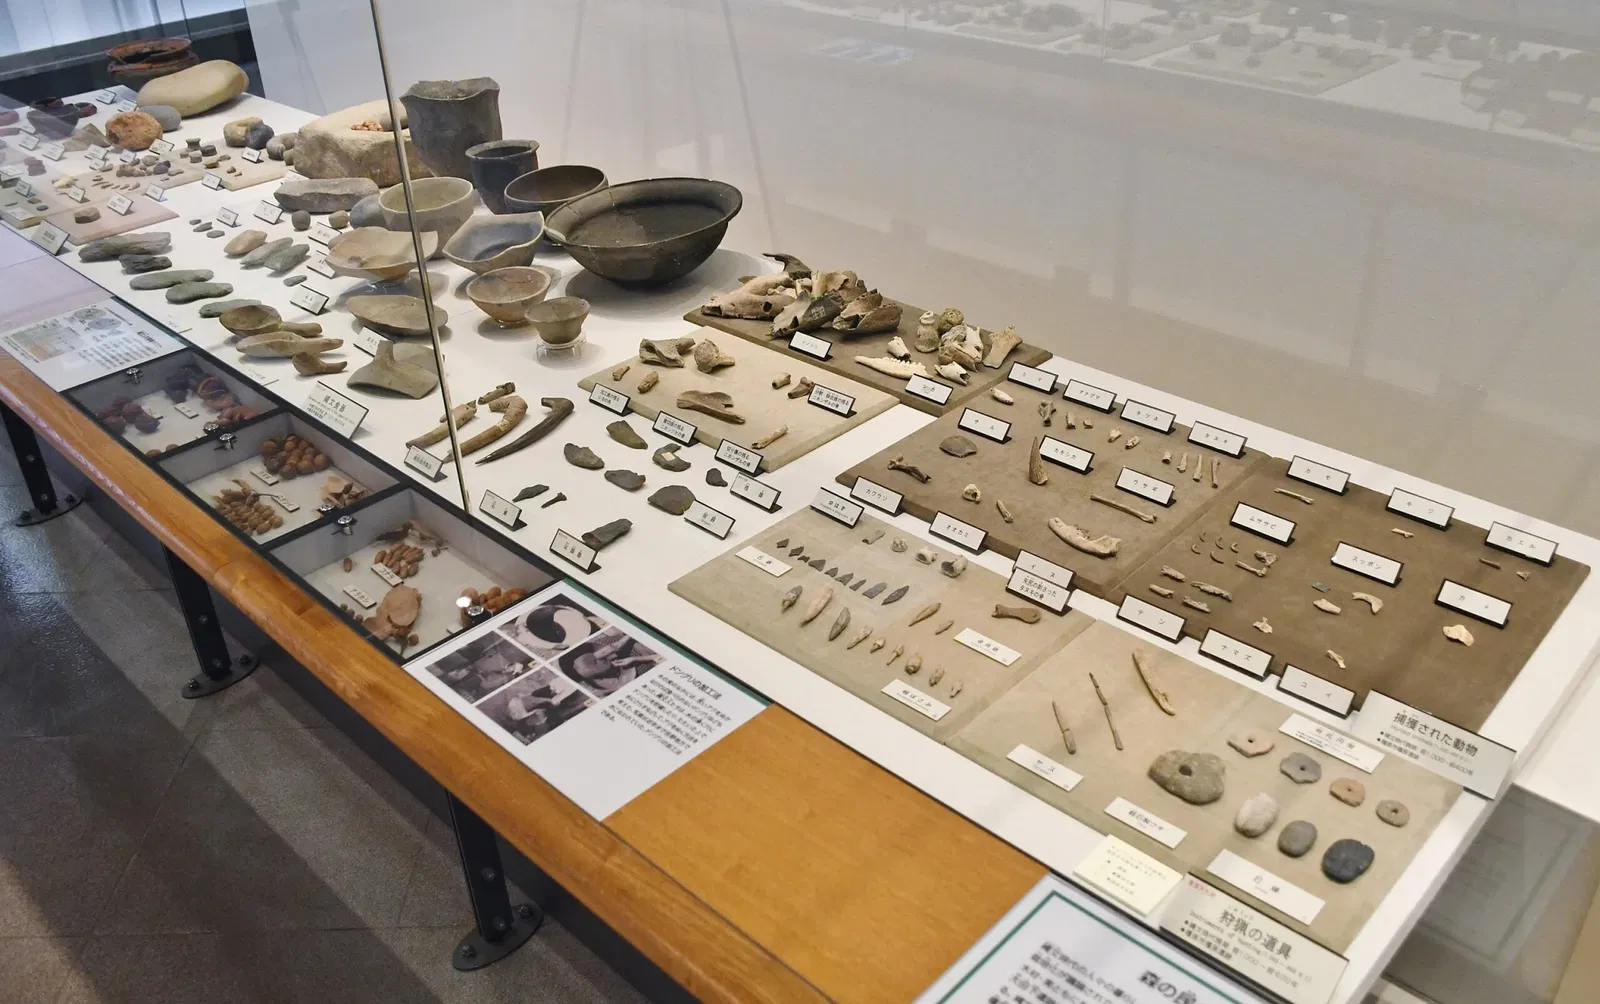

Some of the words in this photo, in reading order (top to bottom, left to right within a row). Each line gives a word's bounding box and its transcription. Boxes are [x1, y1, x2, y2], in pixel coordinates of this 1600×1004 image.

[1053, 447, 1078, 460] カモシカ
[1133, 478, 1159, 492] ウサギ
[865, 488, 888, 501] カワウソ
[1249, 515, 1277, 530] ムササビ
[946, 524, 970, 539] オオカミ
[1506, 534, 1537, 549] カエル
[1351, 555, 1382, 571] スッポン
[1137, 608, 1165, 625] テン
[1222, 644, 1252, 661] ナマズ
[1301, 681, 1332, 698] コイ
[1393, 711, 1478, 757] 捕獲された動物
[1219, 909, 1292, 960] 狩猟の道具
